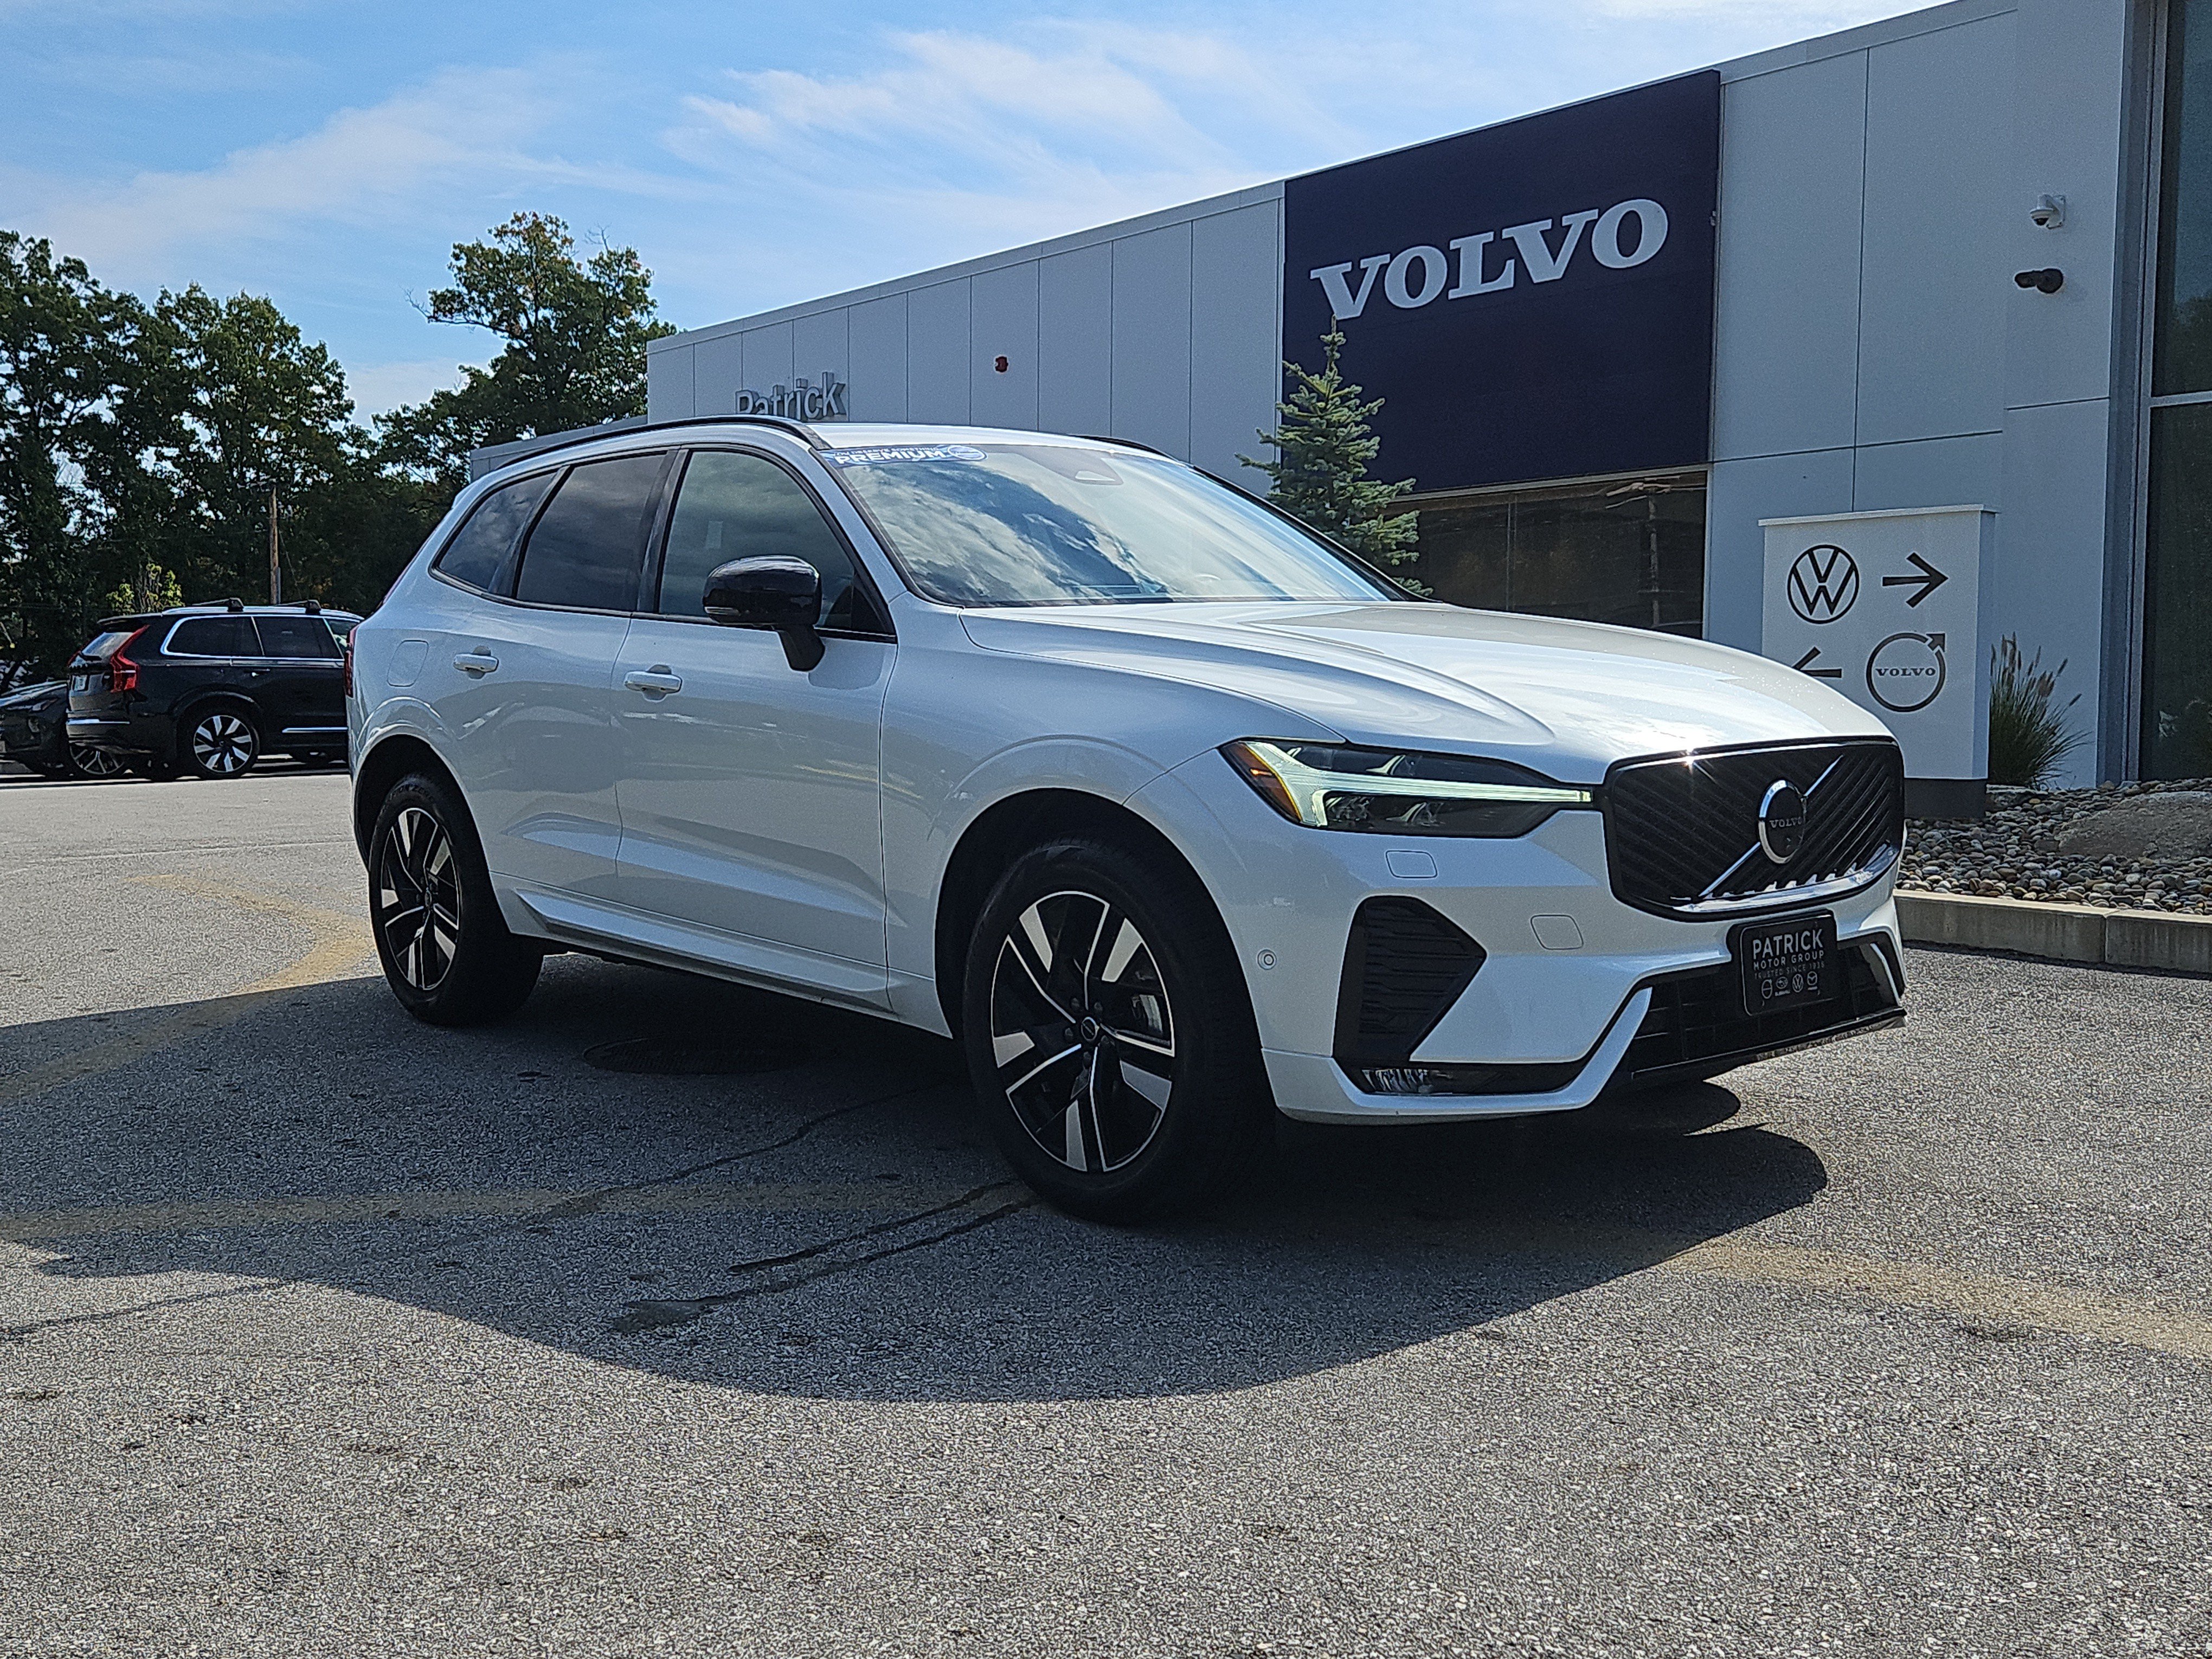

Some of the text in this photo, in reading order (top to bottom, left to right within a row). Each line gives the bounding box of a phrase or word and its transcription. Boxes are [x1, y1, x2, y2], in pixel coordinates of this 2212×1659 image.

[1310, 198, 1668, 320] VOLVO
[736, 372, 846, 420] Patrick
[835, 449, 947, 464] PREMIUM
[1875, 667, 1937, 677] VOLVO
[1769, 816, 1802, 828] VOLVO
[1752, 929, 1823, 960] PATRICK
[1753, 950, 1824, 970] MOTOR GROUP
[1786, 964, 1806, 974] SINCE
